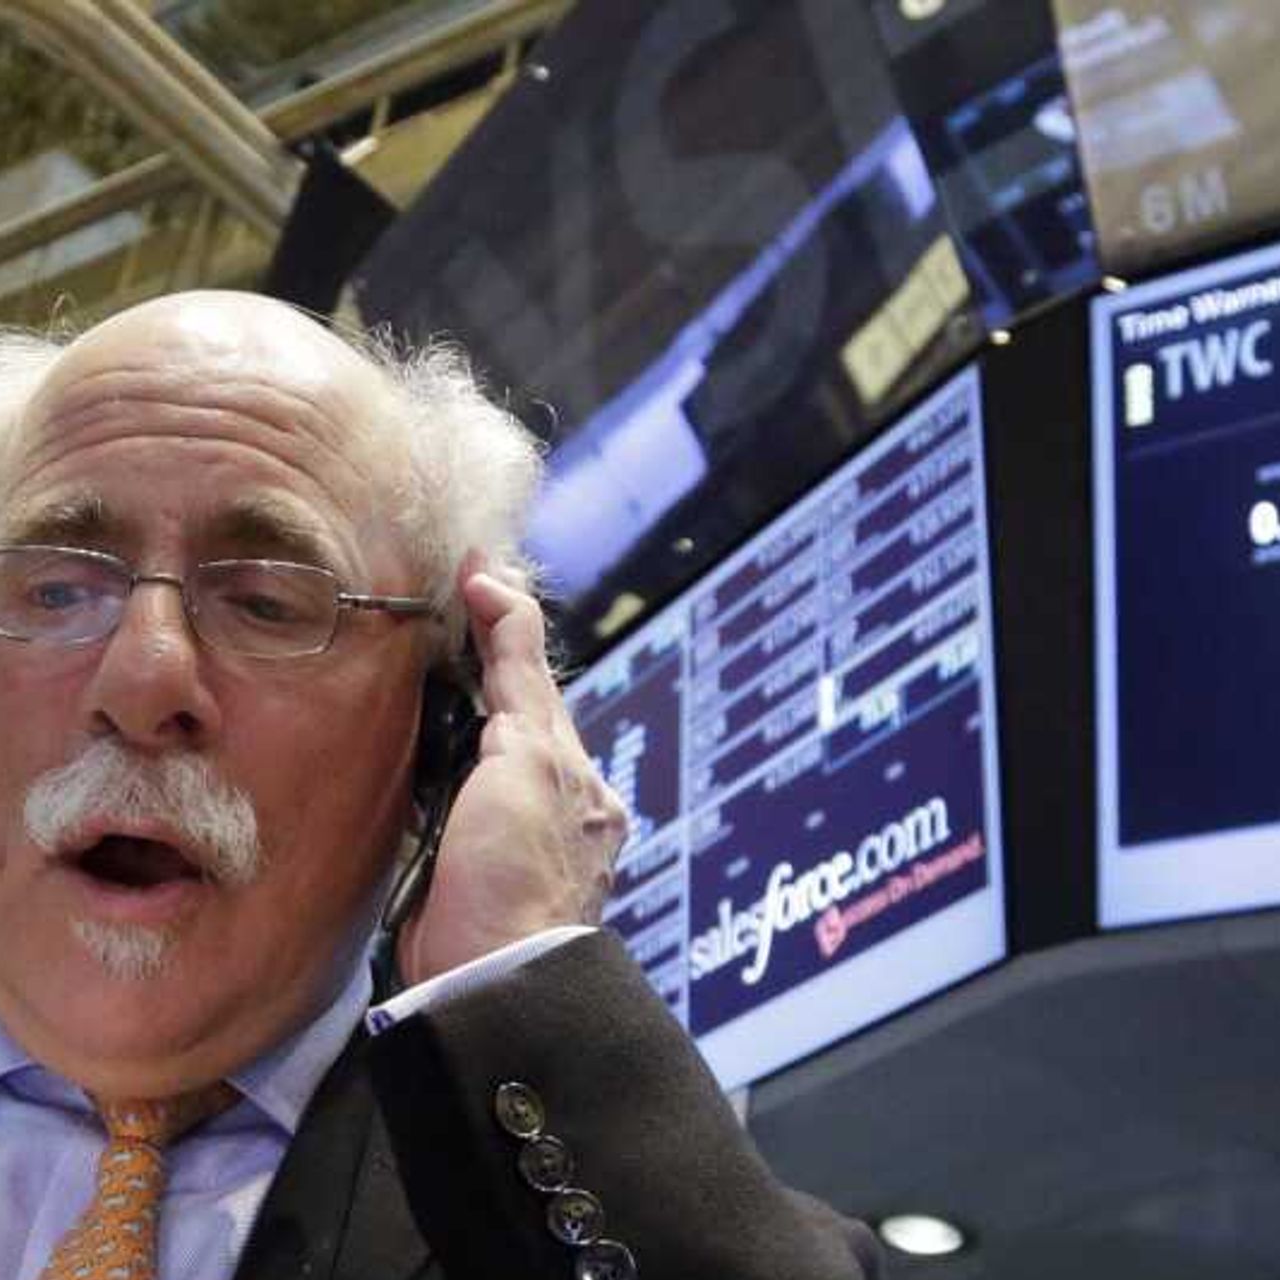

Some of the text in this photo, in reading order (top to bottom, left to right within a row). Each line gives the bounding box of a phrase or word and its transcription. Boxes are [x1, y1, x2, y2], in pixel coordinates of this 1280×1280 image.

[1117, 305, 1190, 343] Time
[1156, 319, 1275, 401] TWC
[690, 796, 952, 985] salesforce.com
